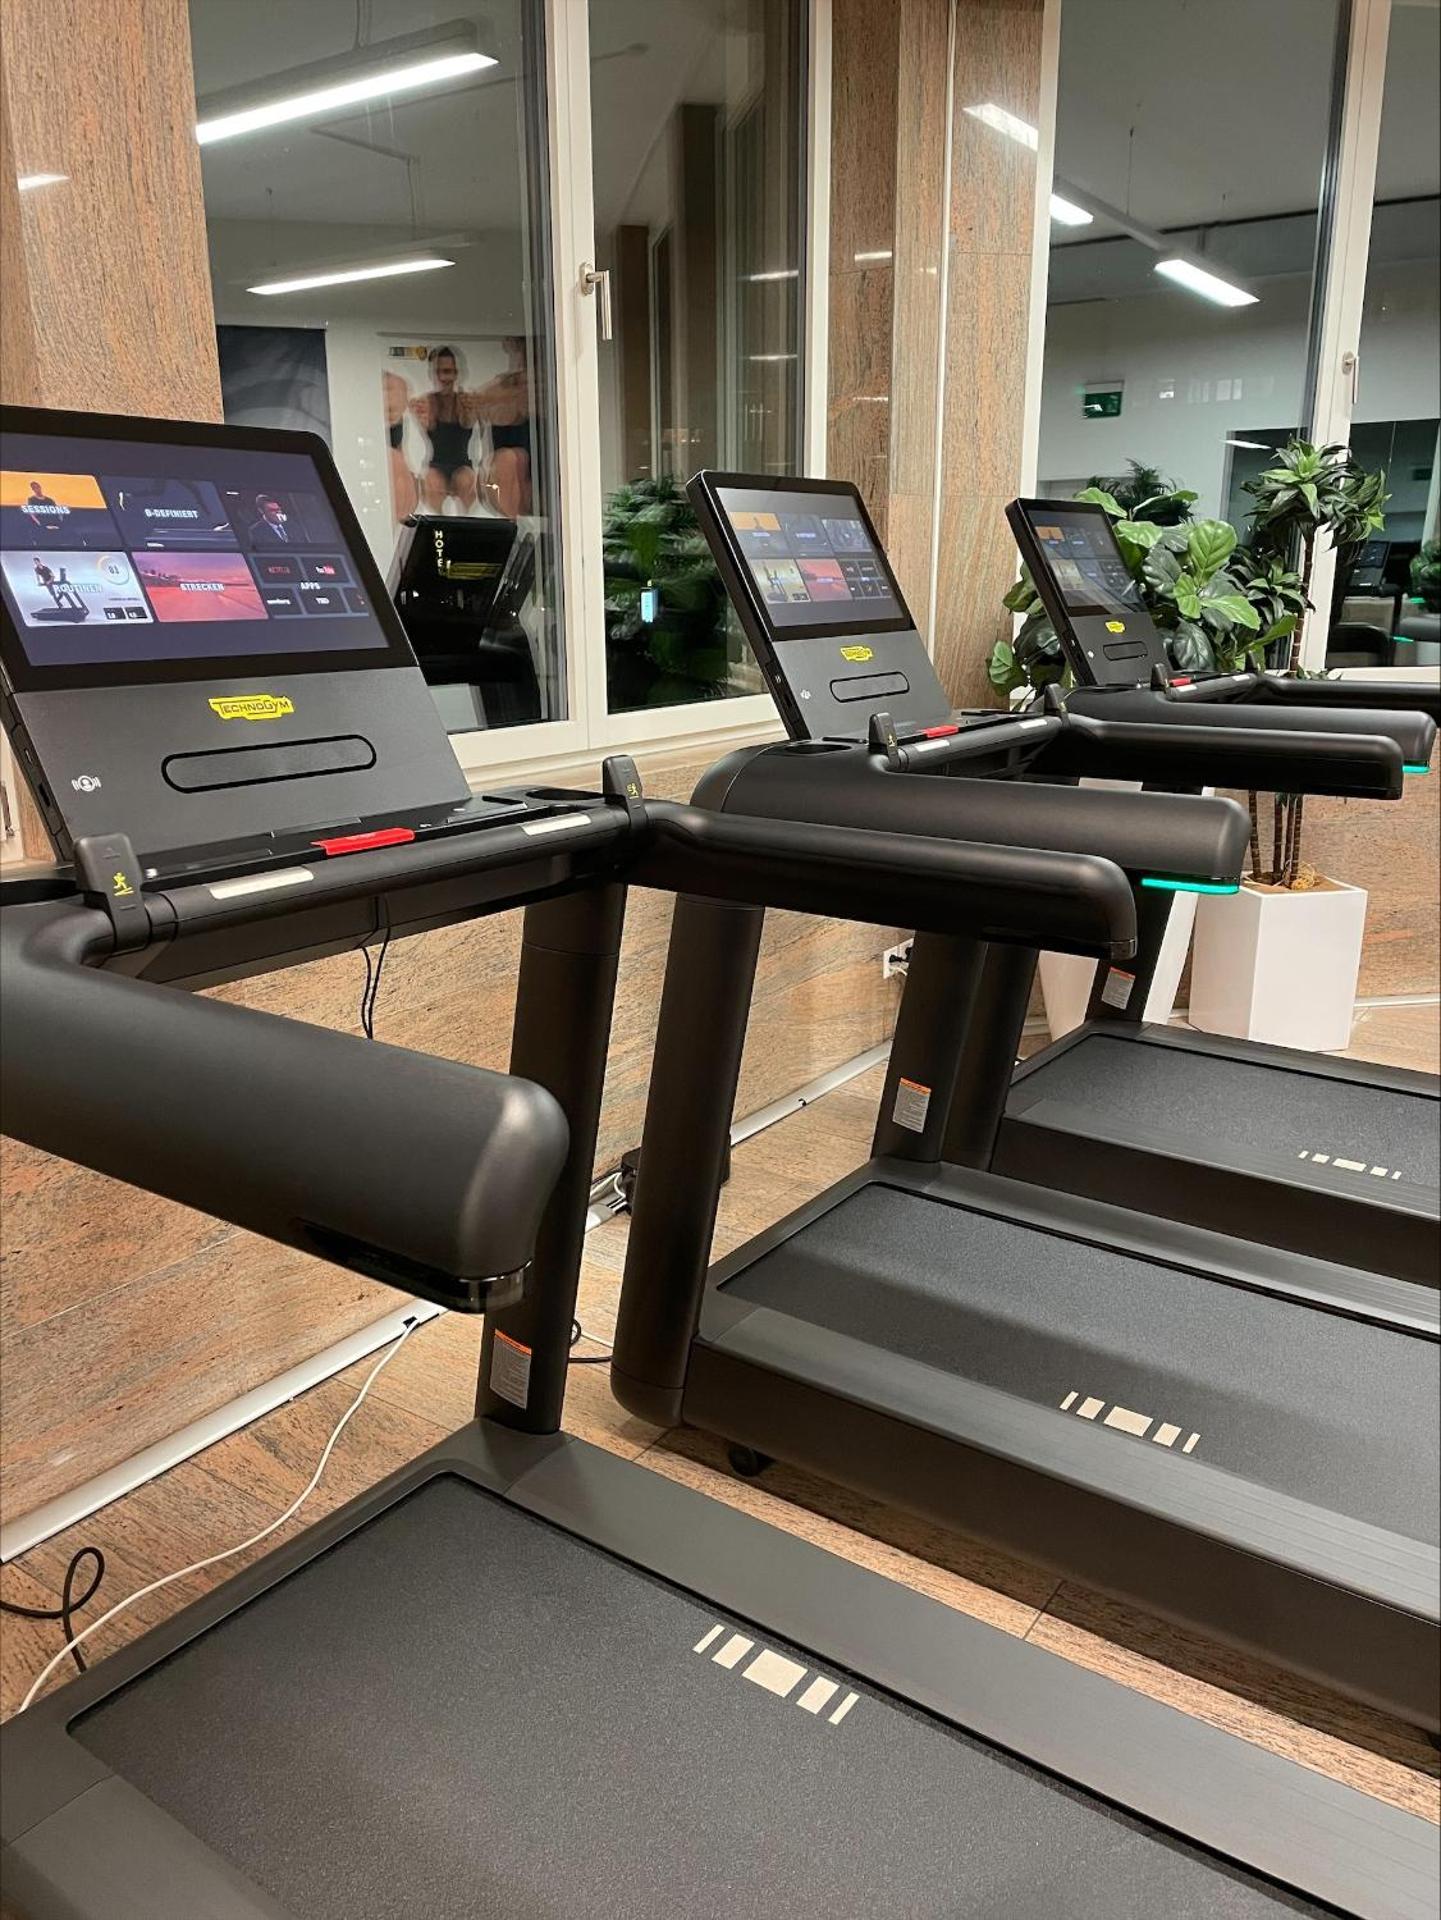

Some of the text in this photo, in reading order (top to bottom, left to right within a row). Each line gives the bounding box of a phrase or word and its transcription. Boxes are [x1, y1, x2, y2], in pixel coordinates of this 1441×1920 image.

[20, 504, 71, 515] SESSIONS
[52, 583, 103, 593] ROUTINEN
[179, 582, 225, 592] STRECKEN
